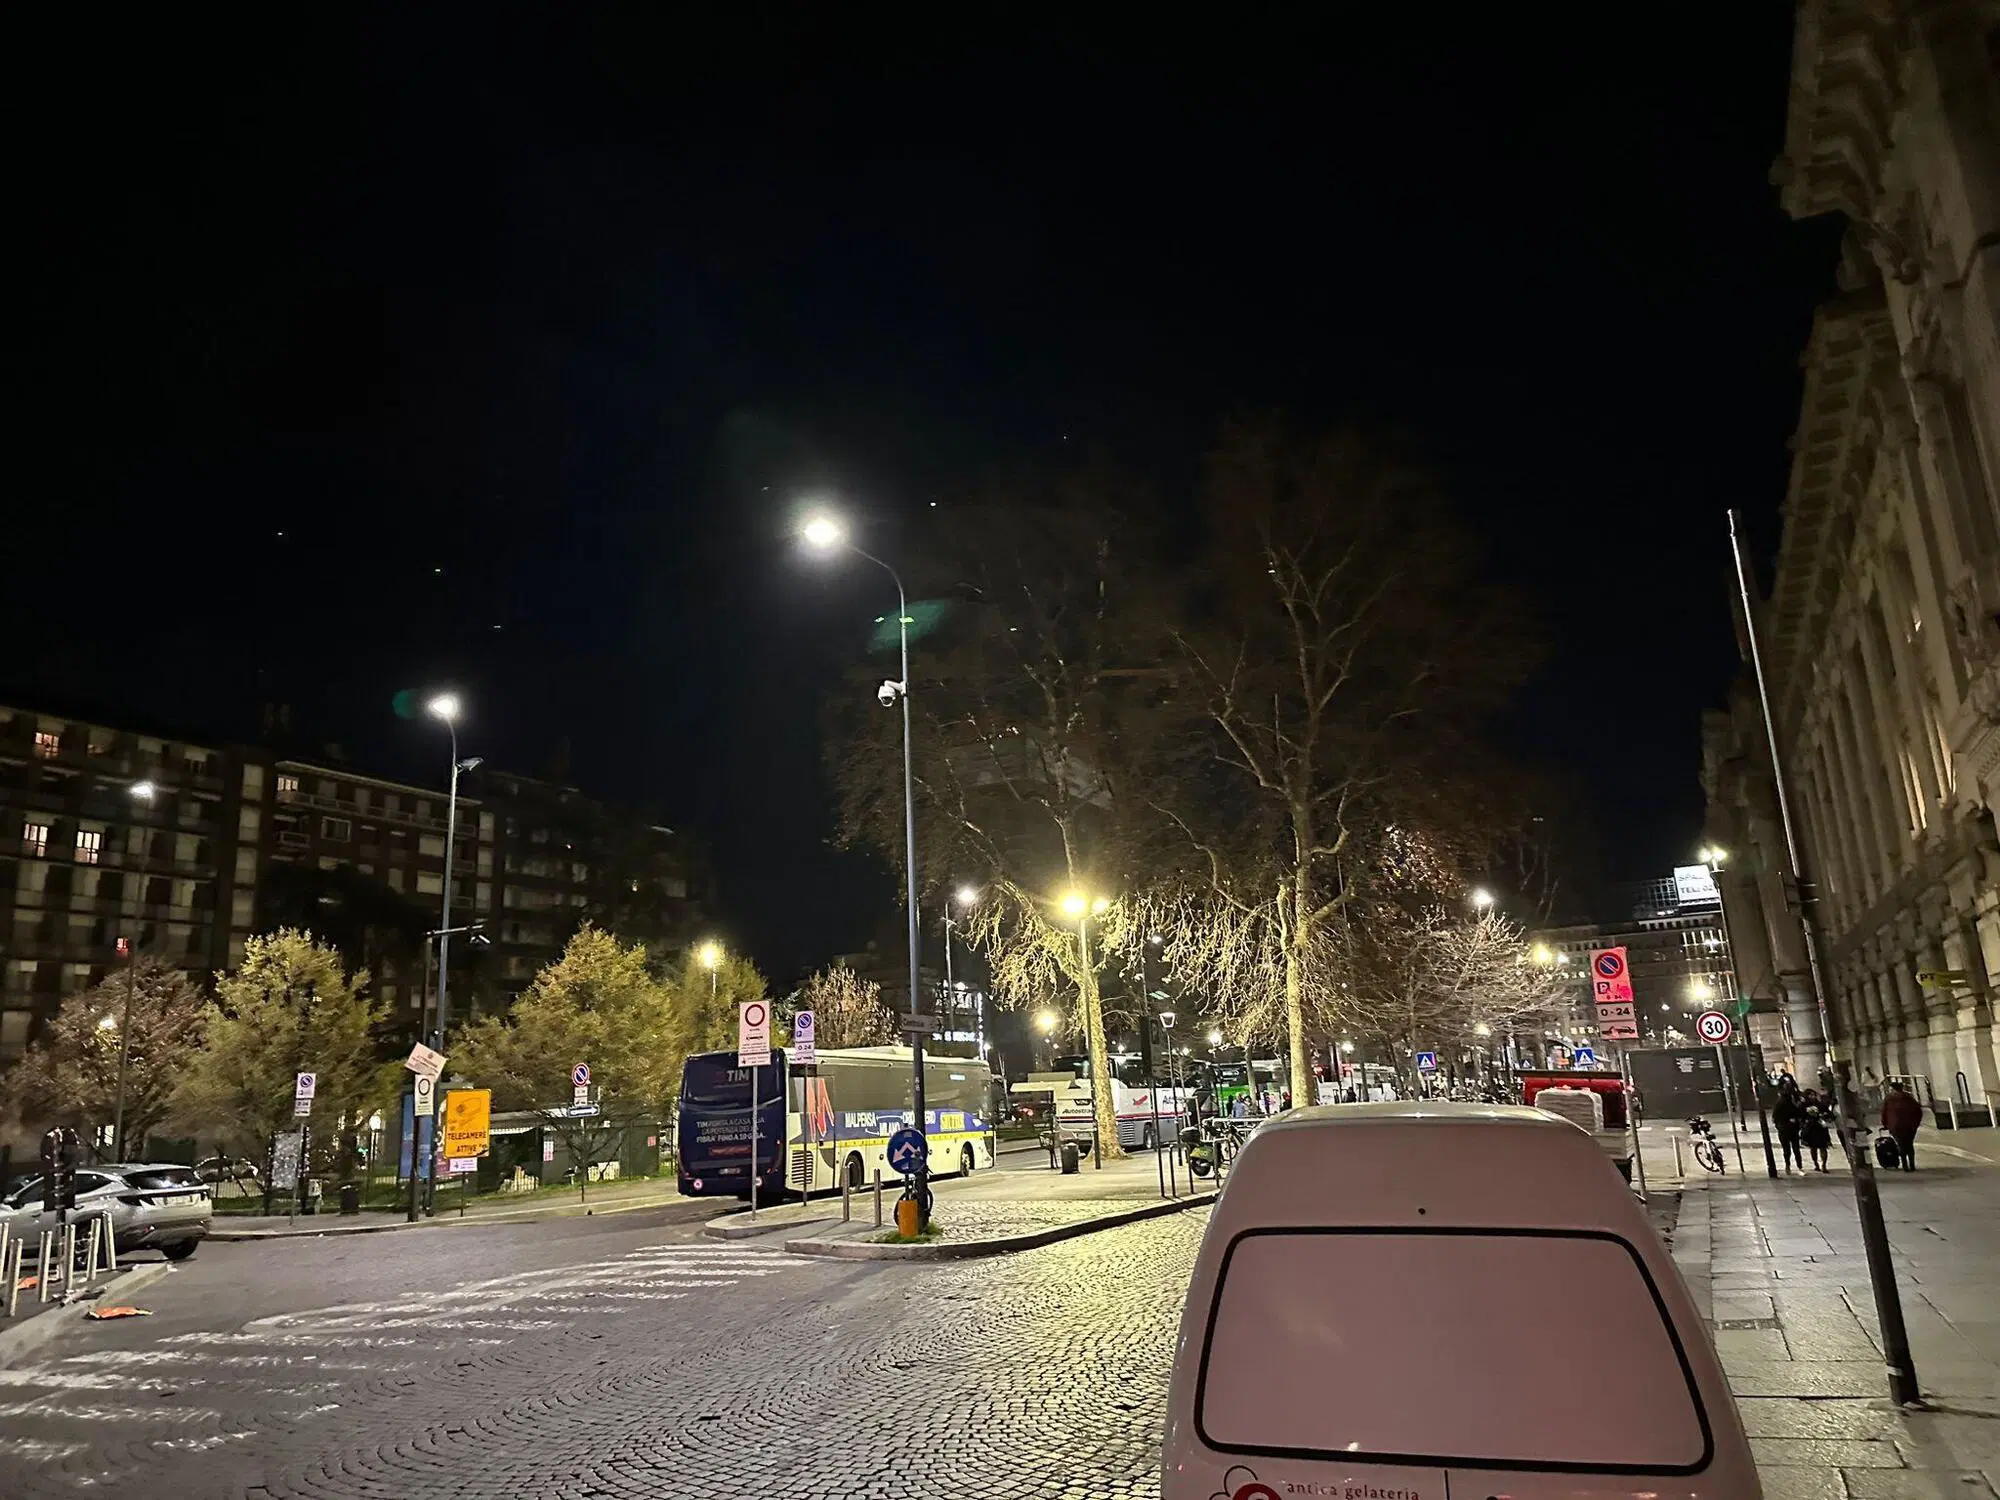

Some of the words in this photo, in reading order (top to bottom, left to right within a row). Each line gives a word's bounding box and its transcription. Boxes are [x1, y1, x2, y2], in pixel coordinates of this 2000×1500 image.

[1704, 1020, 1724, 1034] 30
[726, 1070, 750, 1082] TIM
[844, 1111, 877, 1128] MALPENSA
[447, 1131, 487, 1141] TELECAMERE
[456, 1144, 478, 1153] ATTIVE
[1287, 1481, 1337, 1496] antica
[1344, 1484, 1420, 1500] gelateria
